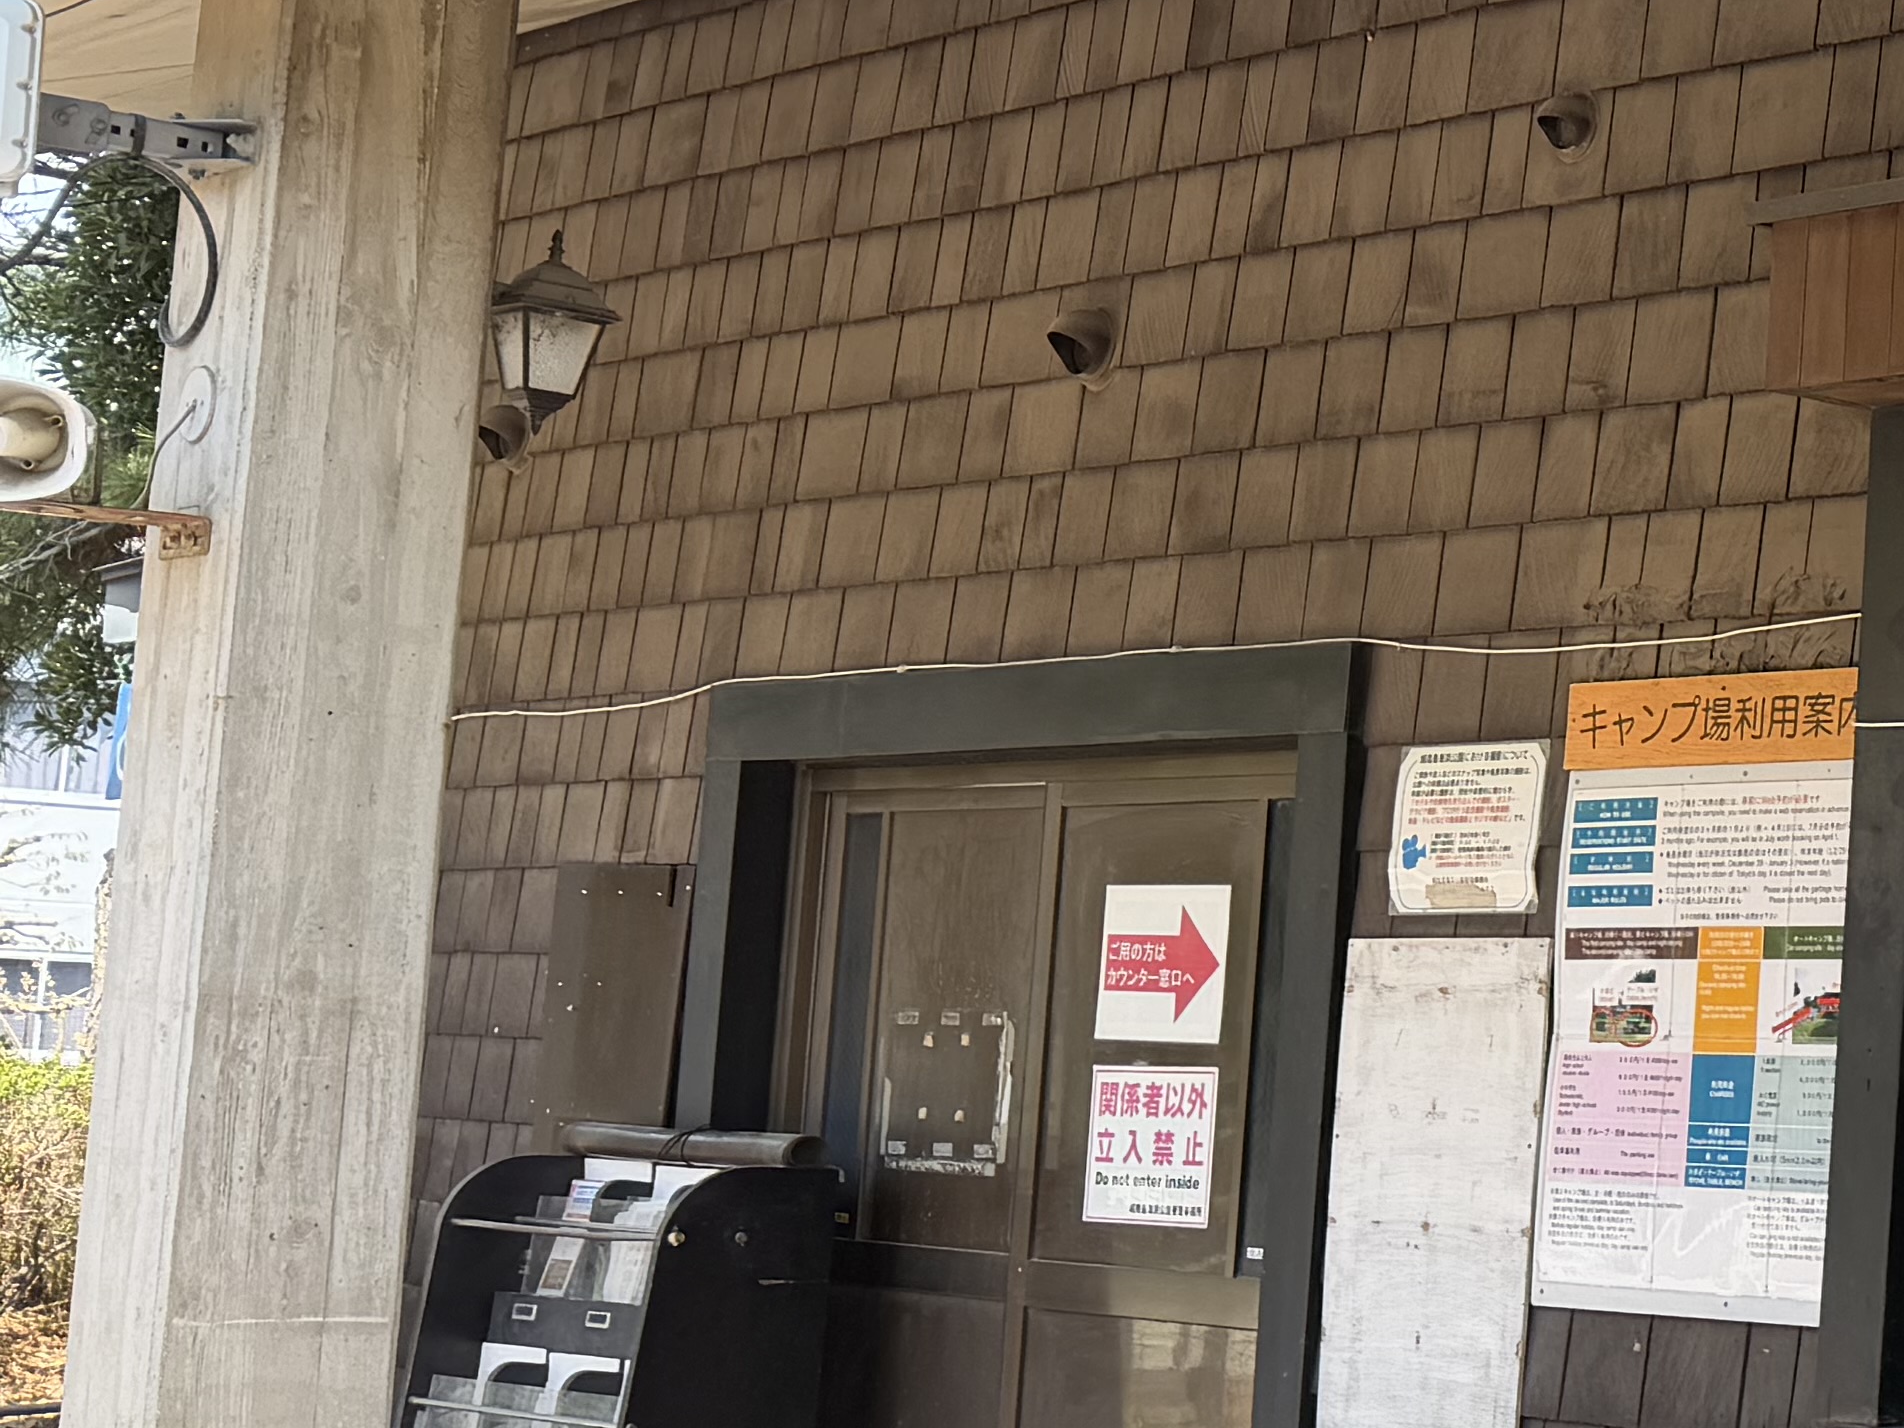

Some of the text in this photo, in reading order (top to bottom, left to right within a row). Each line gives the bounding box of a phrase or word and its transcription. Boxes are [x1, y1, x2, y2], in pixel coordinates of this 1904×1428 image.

[1108, 942, 1166, 962] ご用の方は
[1106, 969, 1195, 988] カウンター窓口へ
[1099, 1081, 1208, 1120] 関係者以外
[1095, 1128, 1204, 1166] 立入禁止
[1095, 1172, 1200, 1190] Do not enter inside
